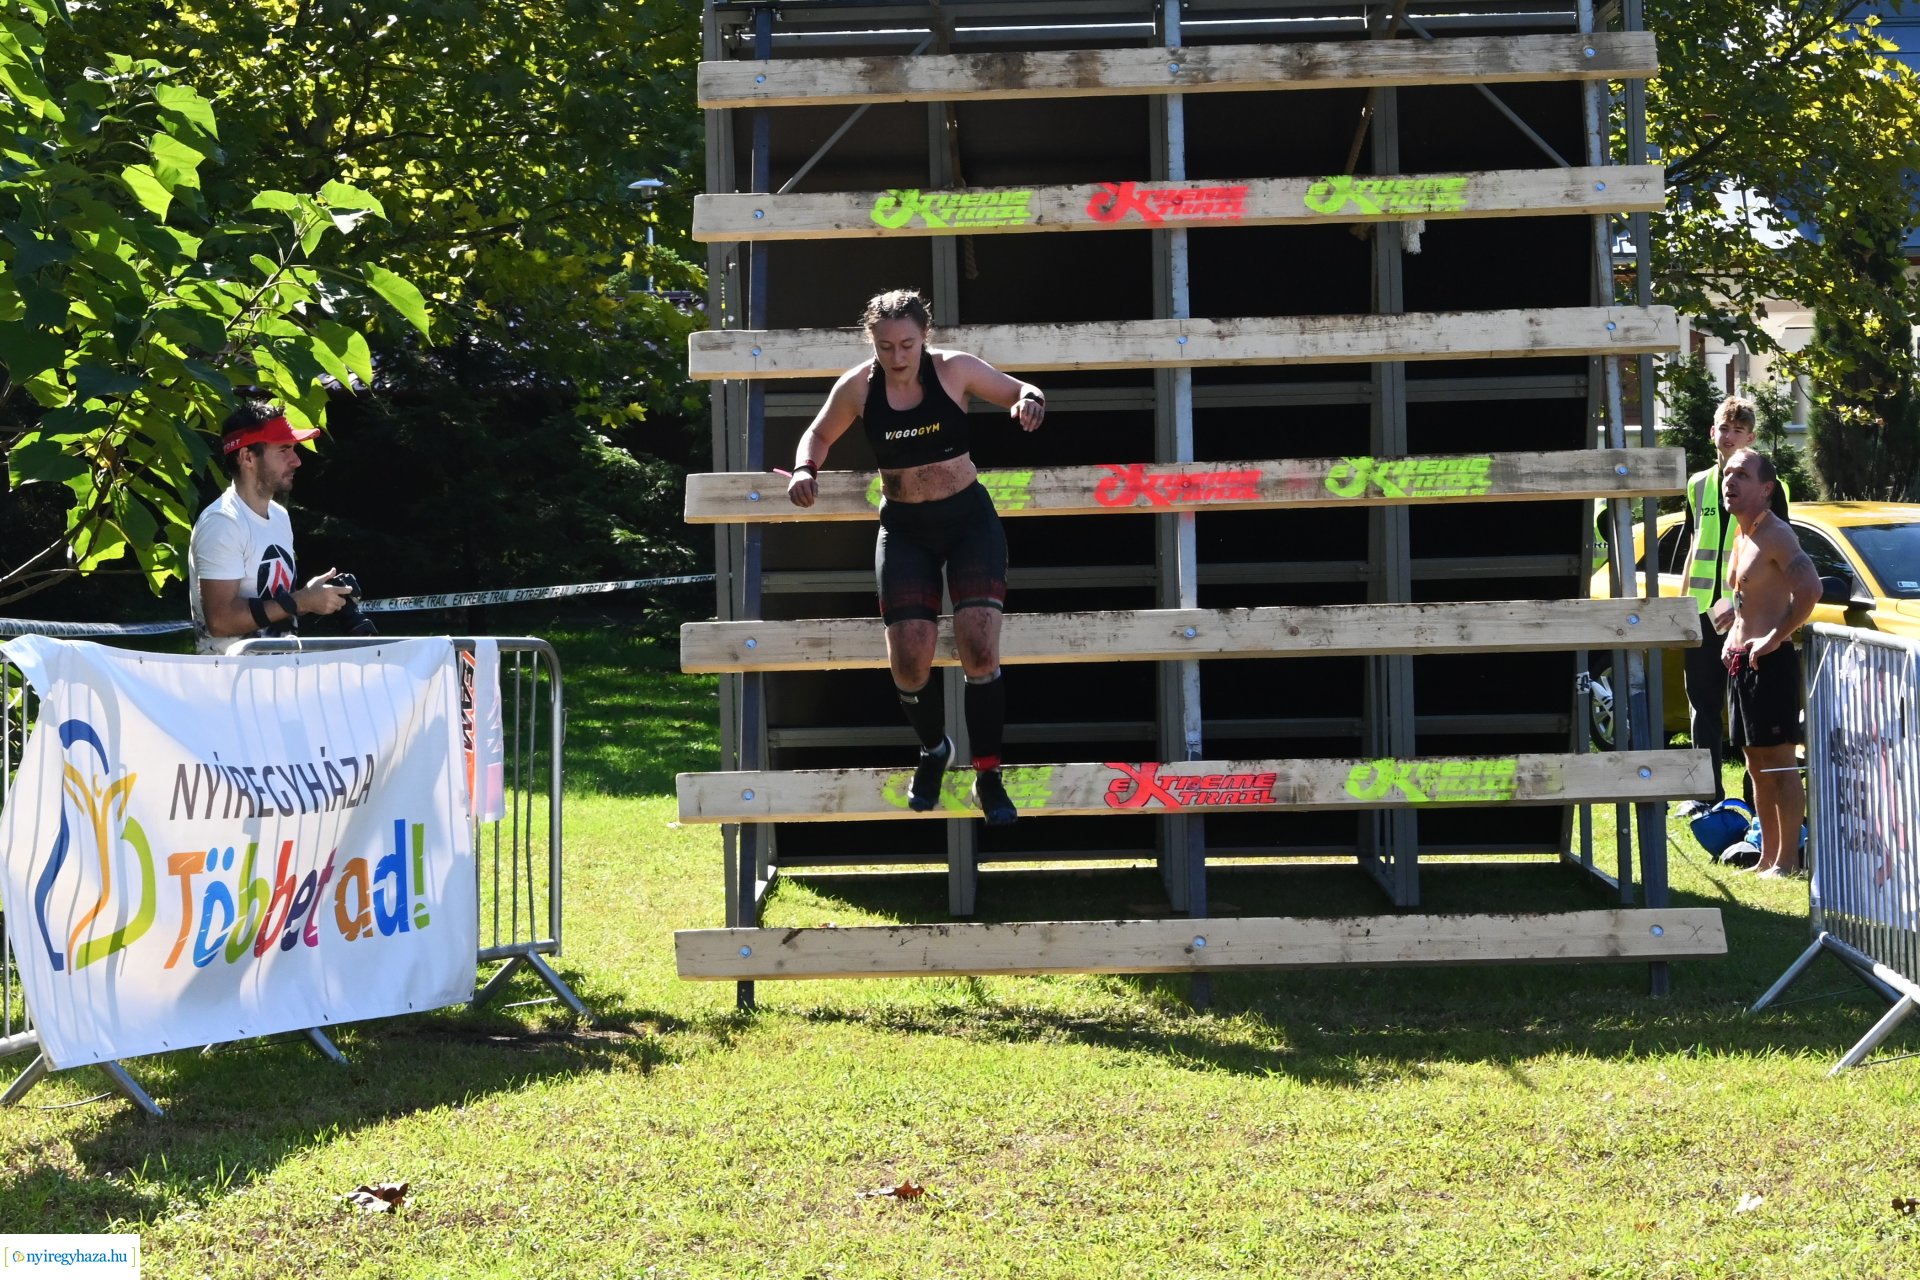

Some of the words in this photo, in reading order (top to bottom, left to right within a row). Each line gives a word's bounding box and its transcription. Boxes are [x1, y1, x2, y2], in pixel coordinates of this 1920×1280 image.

[389, 597, 424, 610] EXTREME
[426, 595, 448, 607] TRAIL
[452, 592, 488, 606] EXTREME
[488, 591, 510, 603] TRAIL
[514, 588, 550, 600] EXTREME
[550, 586, 570, 598] TRAIL
[169, 746, 375, 821] NYÍREGYHÁZA
[1178, 790, 1277, 805] TRAIL
[163, 840, 337, 970] Többet
[334, 819, 430, 942] ad!
